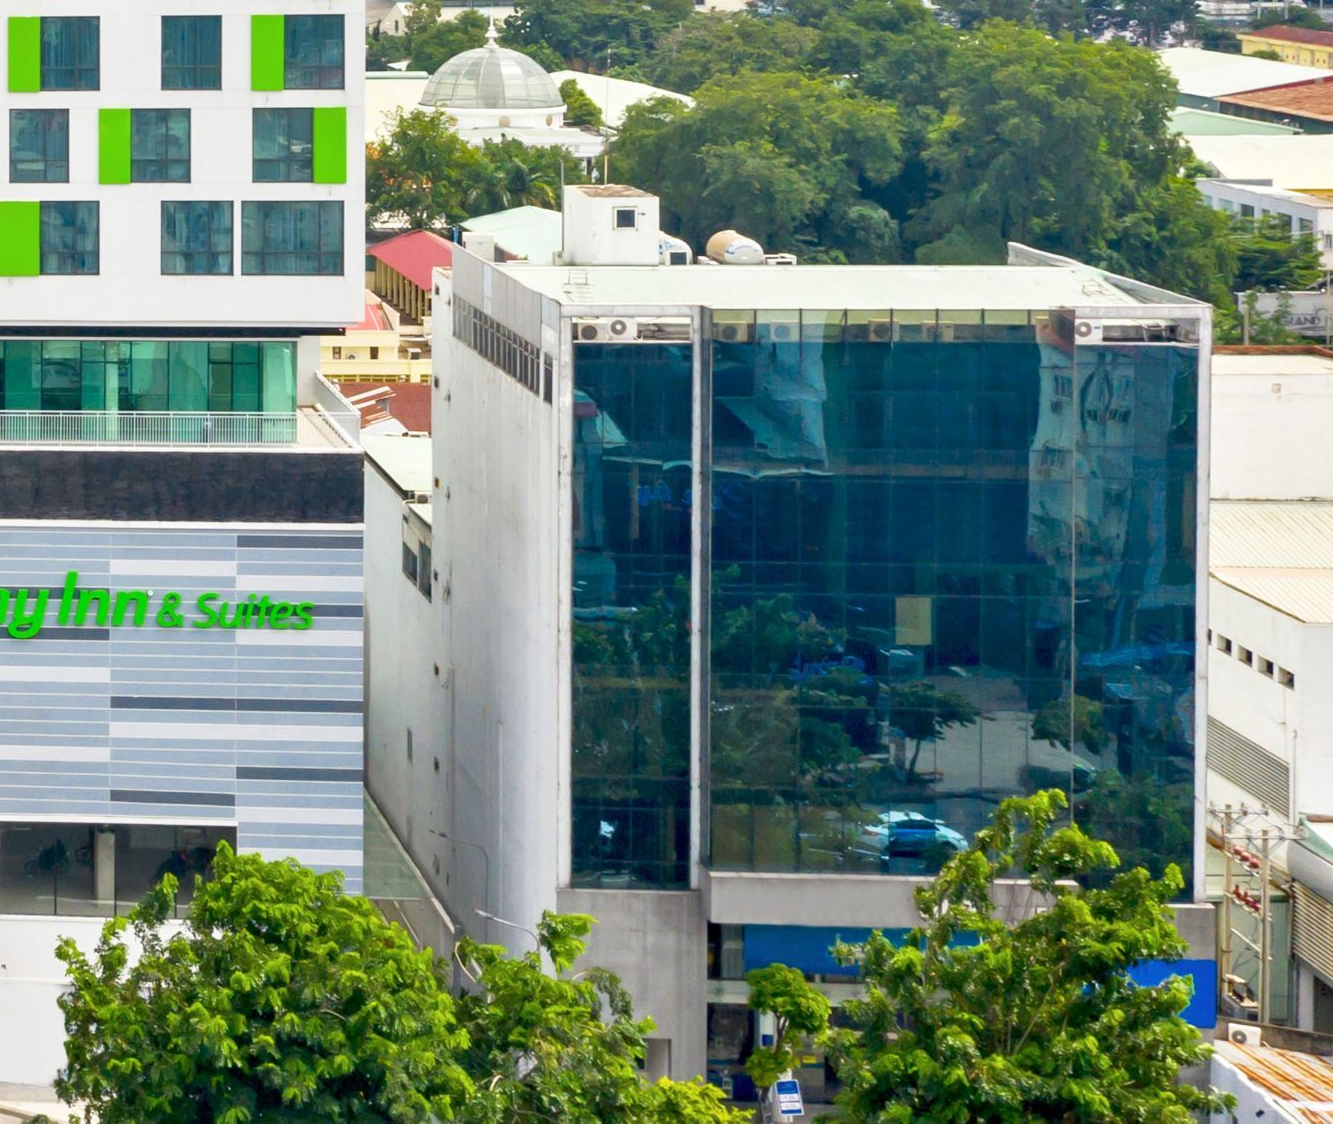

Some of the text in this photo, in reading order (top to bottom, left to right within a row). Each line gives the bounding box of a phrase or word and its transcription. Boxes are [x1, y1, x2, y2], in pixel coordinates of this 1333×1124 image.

[57, 571, 148, 627] Inn
[156, 591, 185, 628] &
[192, 592, 316, 630] Suites
